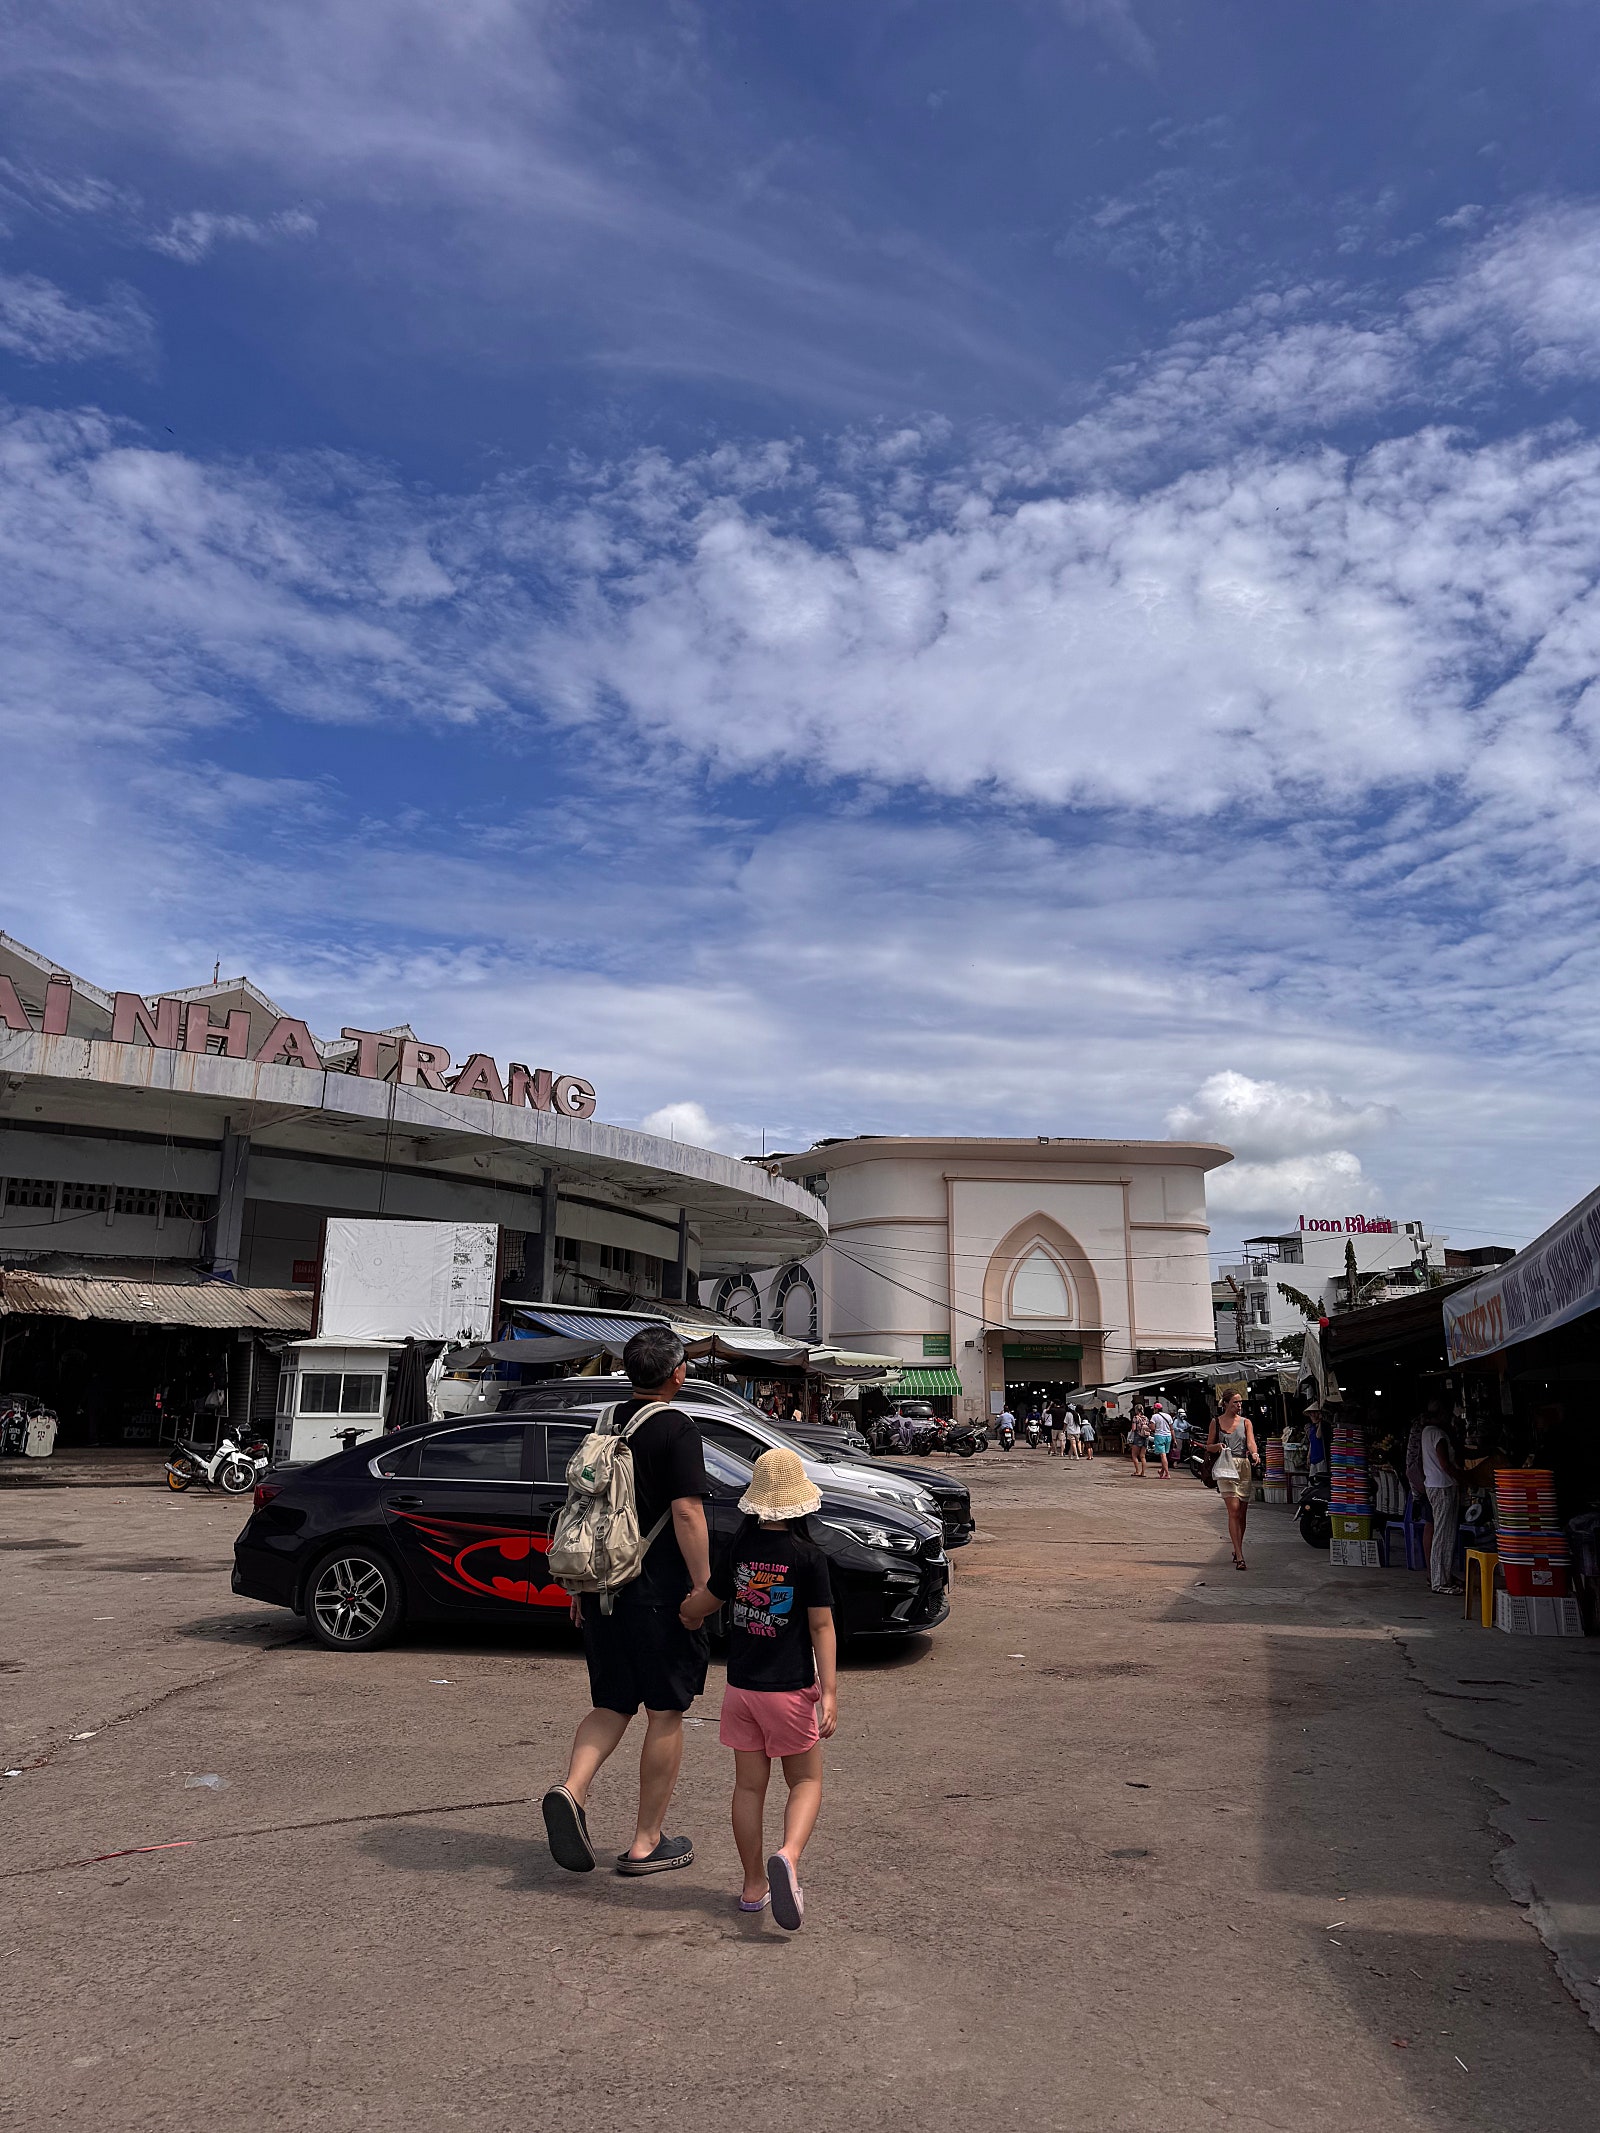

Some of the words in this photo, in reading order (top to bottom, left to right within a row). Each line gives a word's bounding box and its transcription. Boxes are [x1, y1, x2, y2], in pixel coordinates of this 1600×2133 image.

[111, 991, 324, 1070] NHA
[341, 1027, 597, 1119] TRANG
[1299, 1214, 1343, 1233] Loan
[1344, 1213, 1393, 1234] Bikini
[771, 1564, 789, 1573] JUST
[753, 1571, 777, 1583] NIKE
[774, 1592, 788, 1601] NIKE
[748, 1607, 760, 1619] DO
